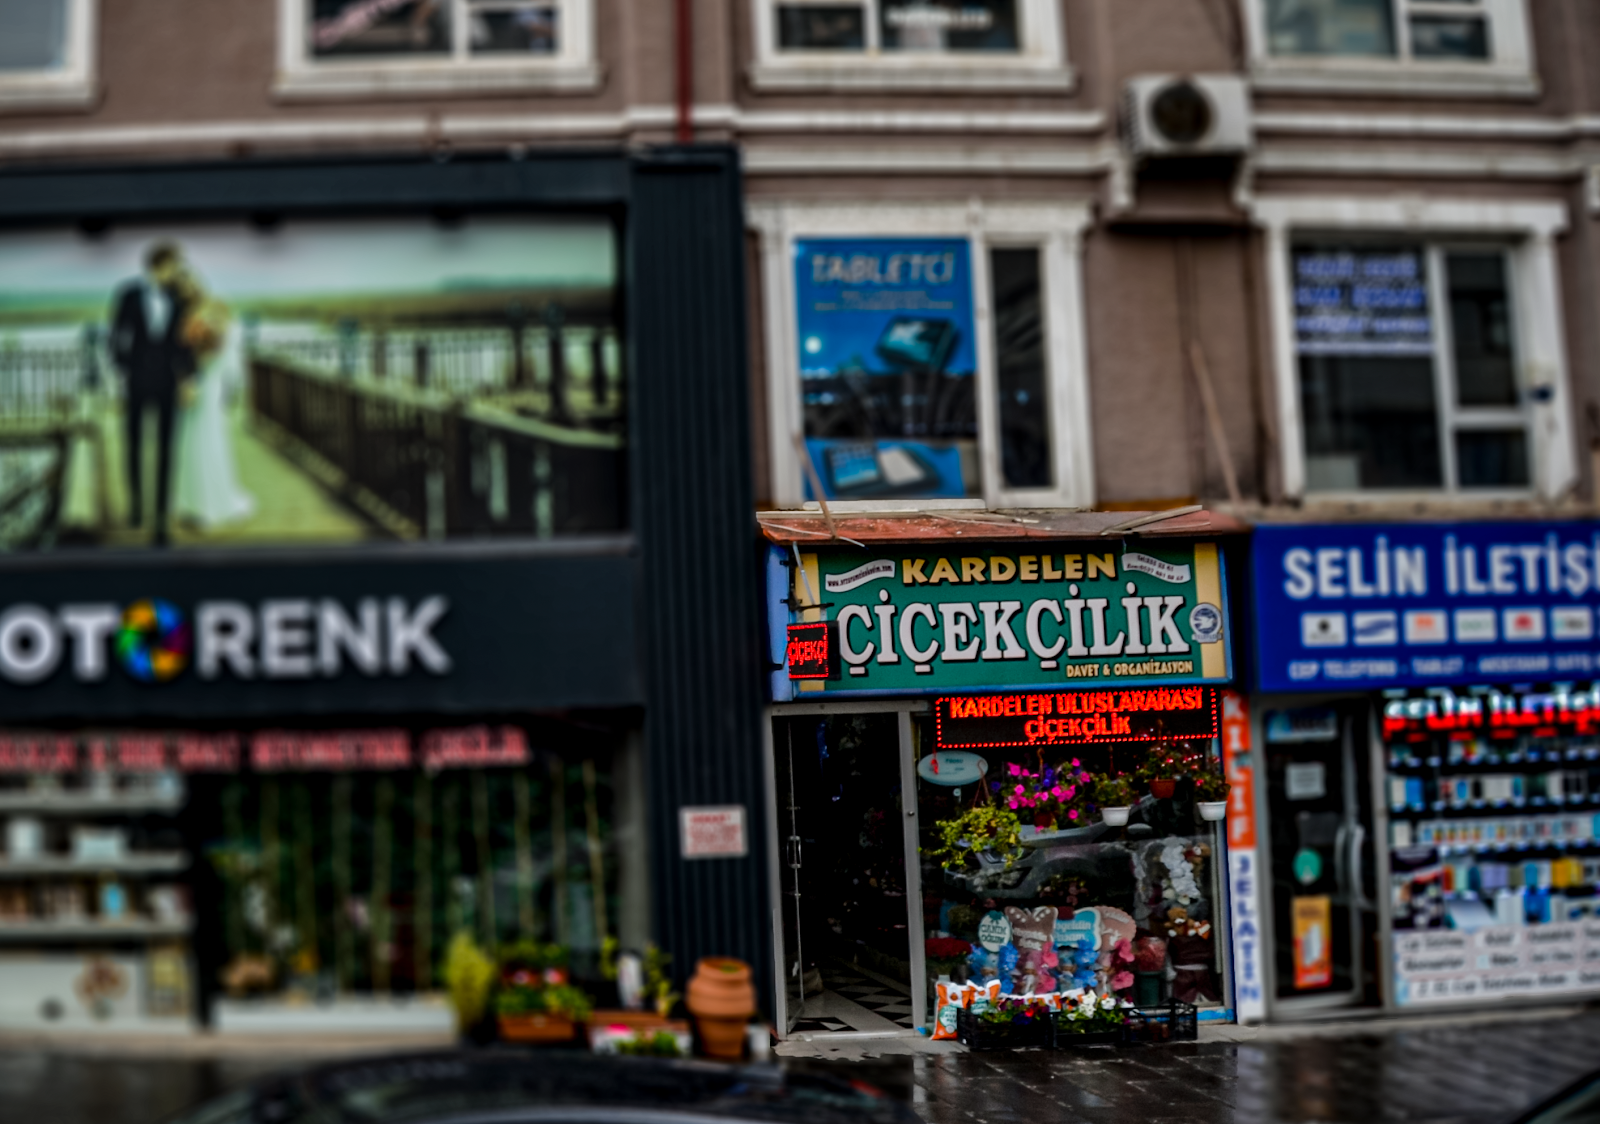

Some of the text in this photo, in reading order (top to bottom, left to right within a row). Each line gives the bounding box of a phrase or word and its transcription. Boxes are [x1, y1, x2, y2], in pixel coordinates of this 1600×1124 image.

[902, 552, 1117, 584] KARDELEN
[1284, 535, 1428, 599] SELİN
[837, 582, 1190, 674] ÇİÇEKÇİLİK
[1066, 659, 1193, 678] DAVET & ORGANİZASYON
[951, 690, 1202, 718] KARDELEN ULUSLARARASI
[1024, 713, 1131, 742] ÇİÇEKÇİLİK
[1223, 696, 1247, 841] KILIF
